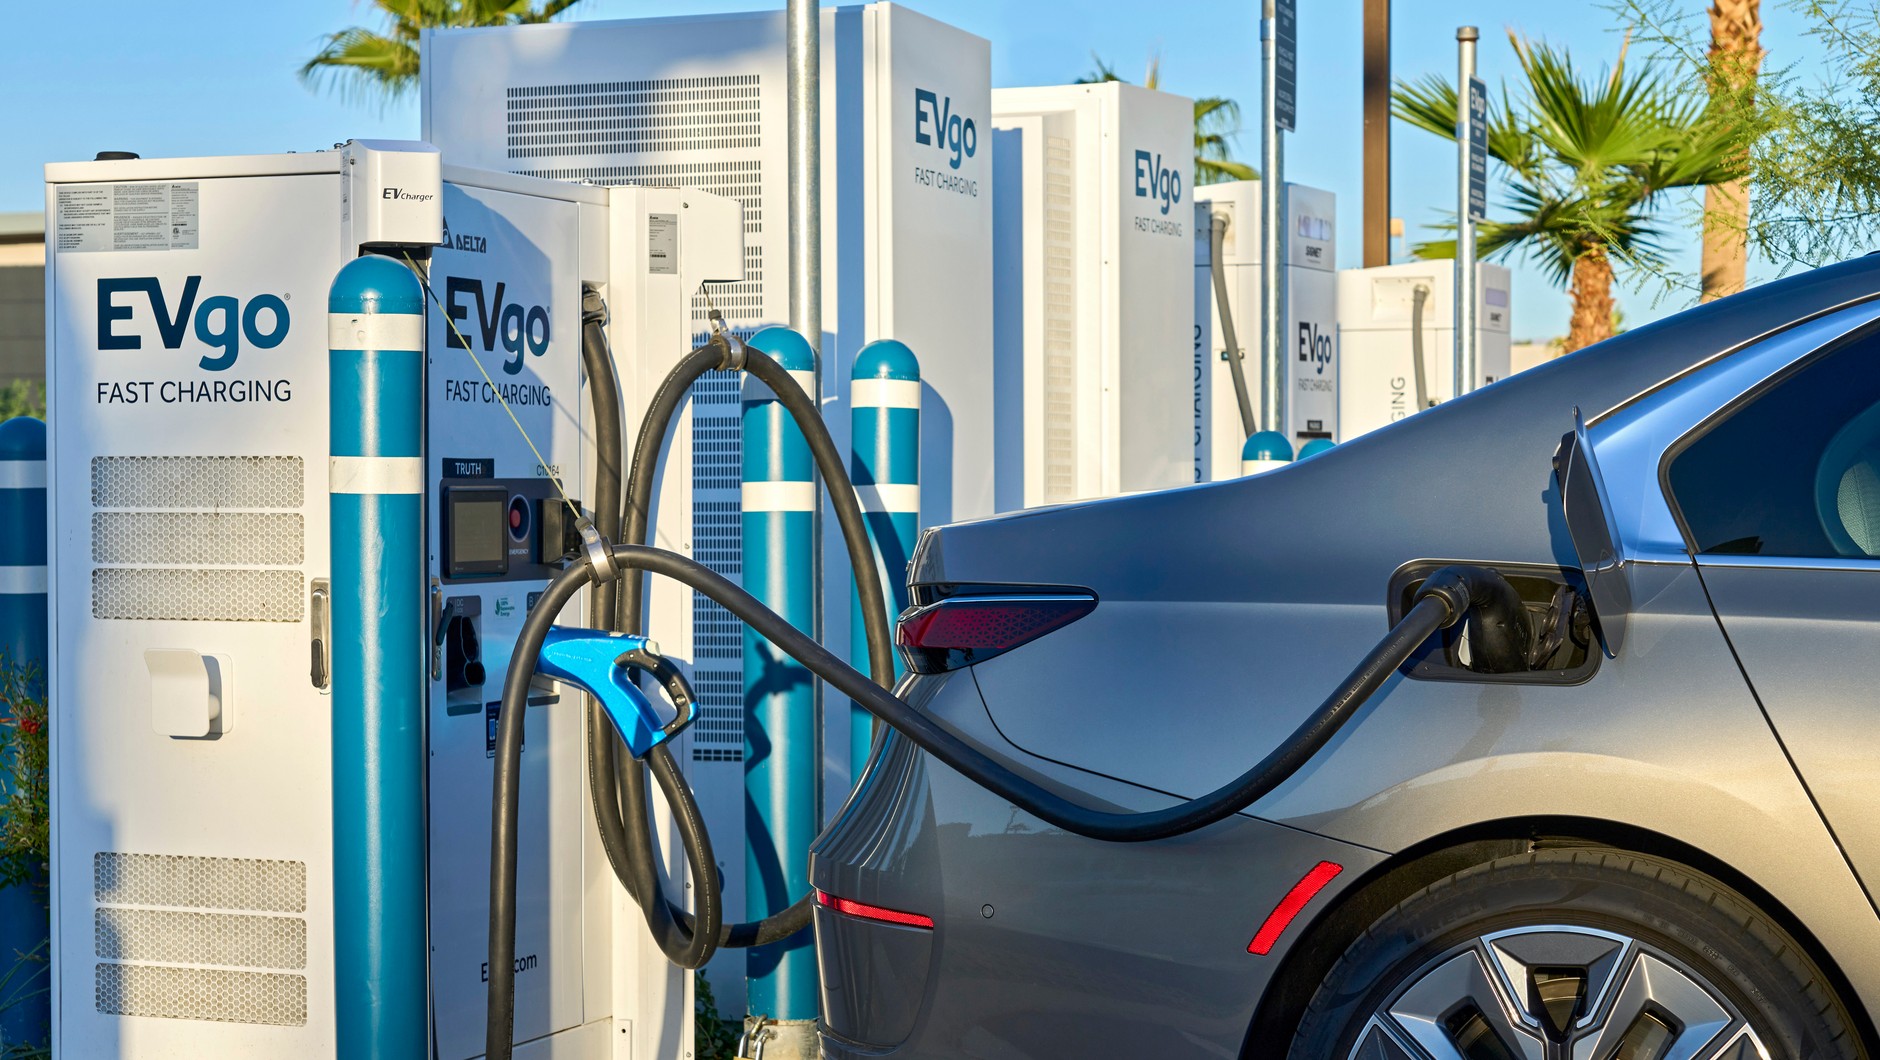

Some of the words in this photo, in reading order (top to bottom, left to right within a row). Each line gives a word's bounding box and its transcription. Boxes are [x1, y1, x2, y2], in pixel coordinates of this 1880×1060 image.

[915, 88, 977, 170] EVgo
[915, 167, 935, 187] FAST
[937, 172, 977, 197] CHARGING
[1135, 149, 1181, 215] EVgo
[1134, 216, 1150, 232] FAST
[1151, 219, 1182, 237] CHARGING
[456, 234, 486, 253] DELTA
[97, 275, 291, 371] EVgo
[446, 276, 551, 375] EVgo
[1299, 321, 1332, 375] EVgo
[97, 382, 154, 404] FAST
[160, 379, 292, 404] CHARGING
[446, 380, 479, 402] FAST
[482, 381, 551, 407] CHARGING
[455, 462, 482, 475] TRUTH
